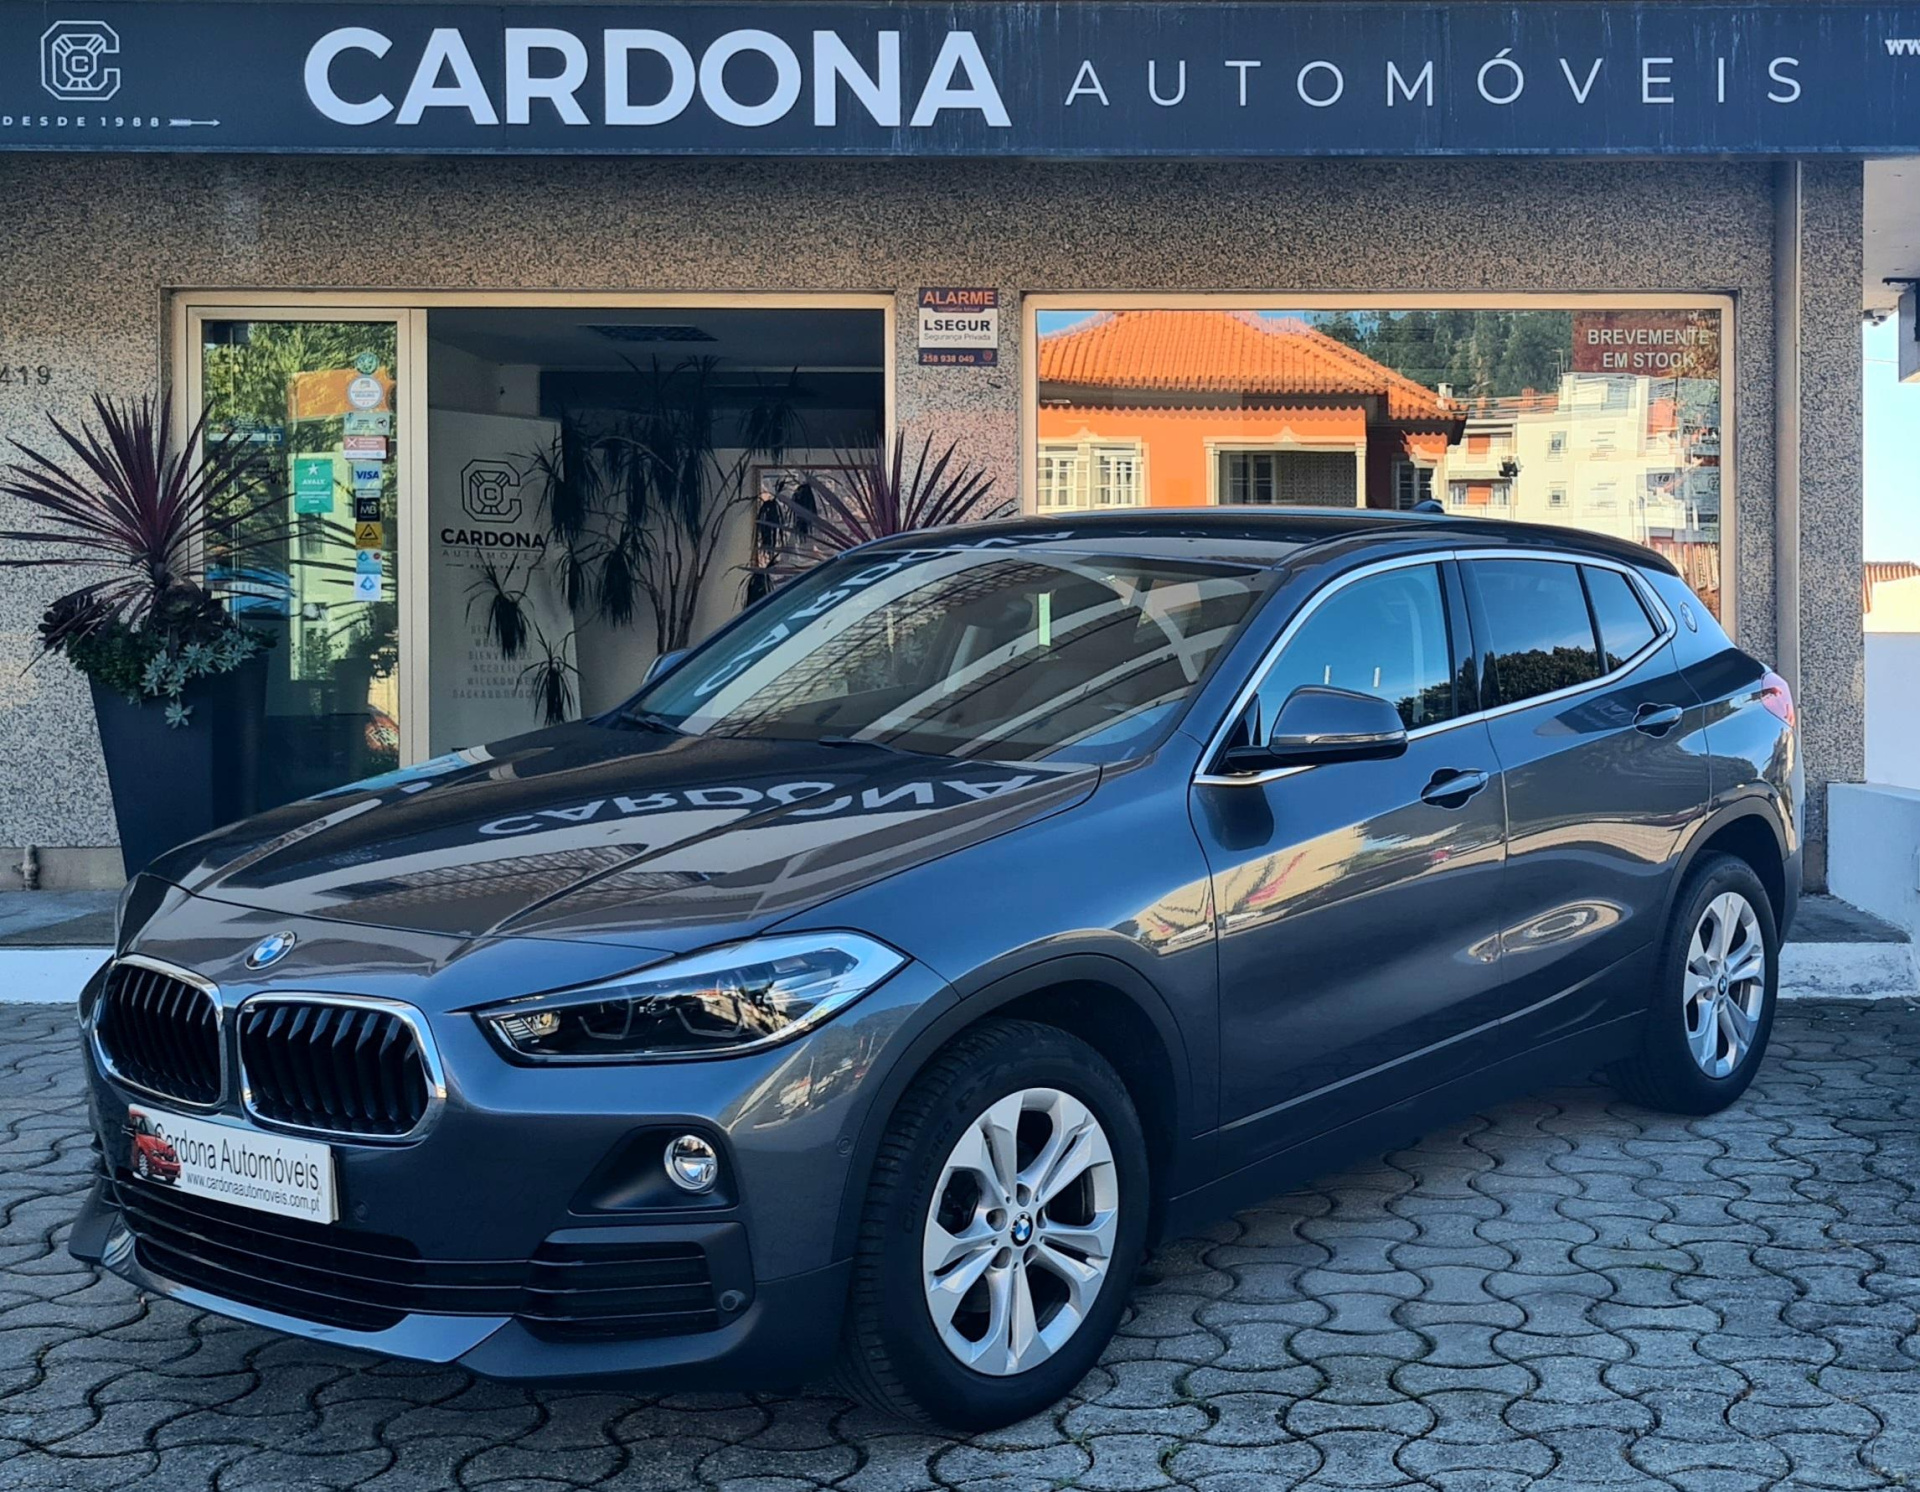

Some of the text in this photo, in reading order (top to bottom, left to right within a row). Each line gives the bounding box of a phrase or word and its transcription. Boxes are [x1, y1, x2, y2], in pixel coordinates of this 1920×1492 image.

[304, 26, 1802, 127] CARDONA AUTOMÓVEIS
[2, 116, 160, 127] DESDE 1988
[922, 290, 995, 305] ALARME
[924, 319, 991, 332] LSEGUR
[923, 332, 991, 342] Segurança Privada
[1587, 328, 1710, 345] BREVEMENTE
[1602, 351, 1696, 369] EM STOCK
[0, 364, 51, 386] 419
[355, 470, 380, 480] VISA
[440, 527, 546, 549] CARDONA
[154, 1122, 320, 1191] Cardona Automóveis
